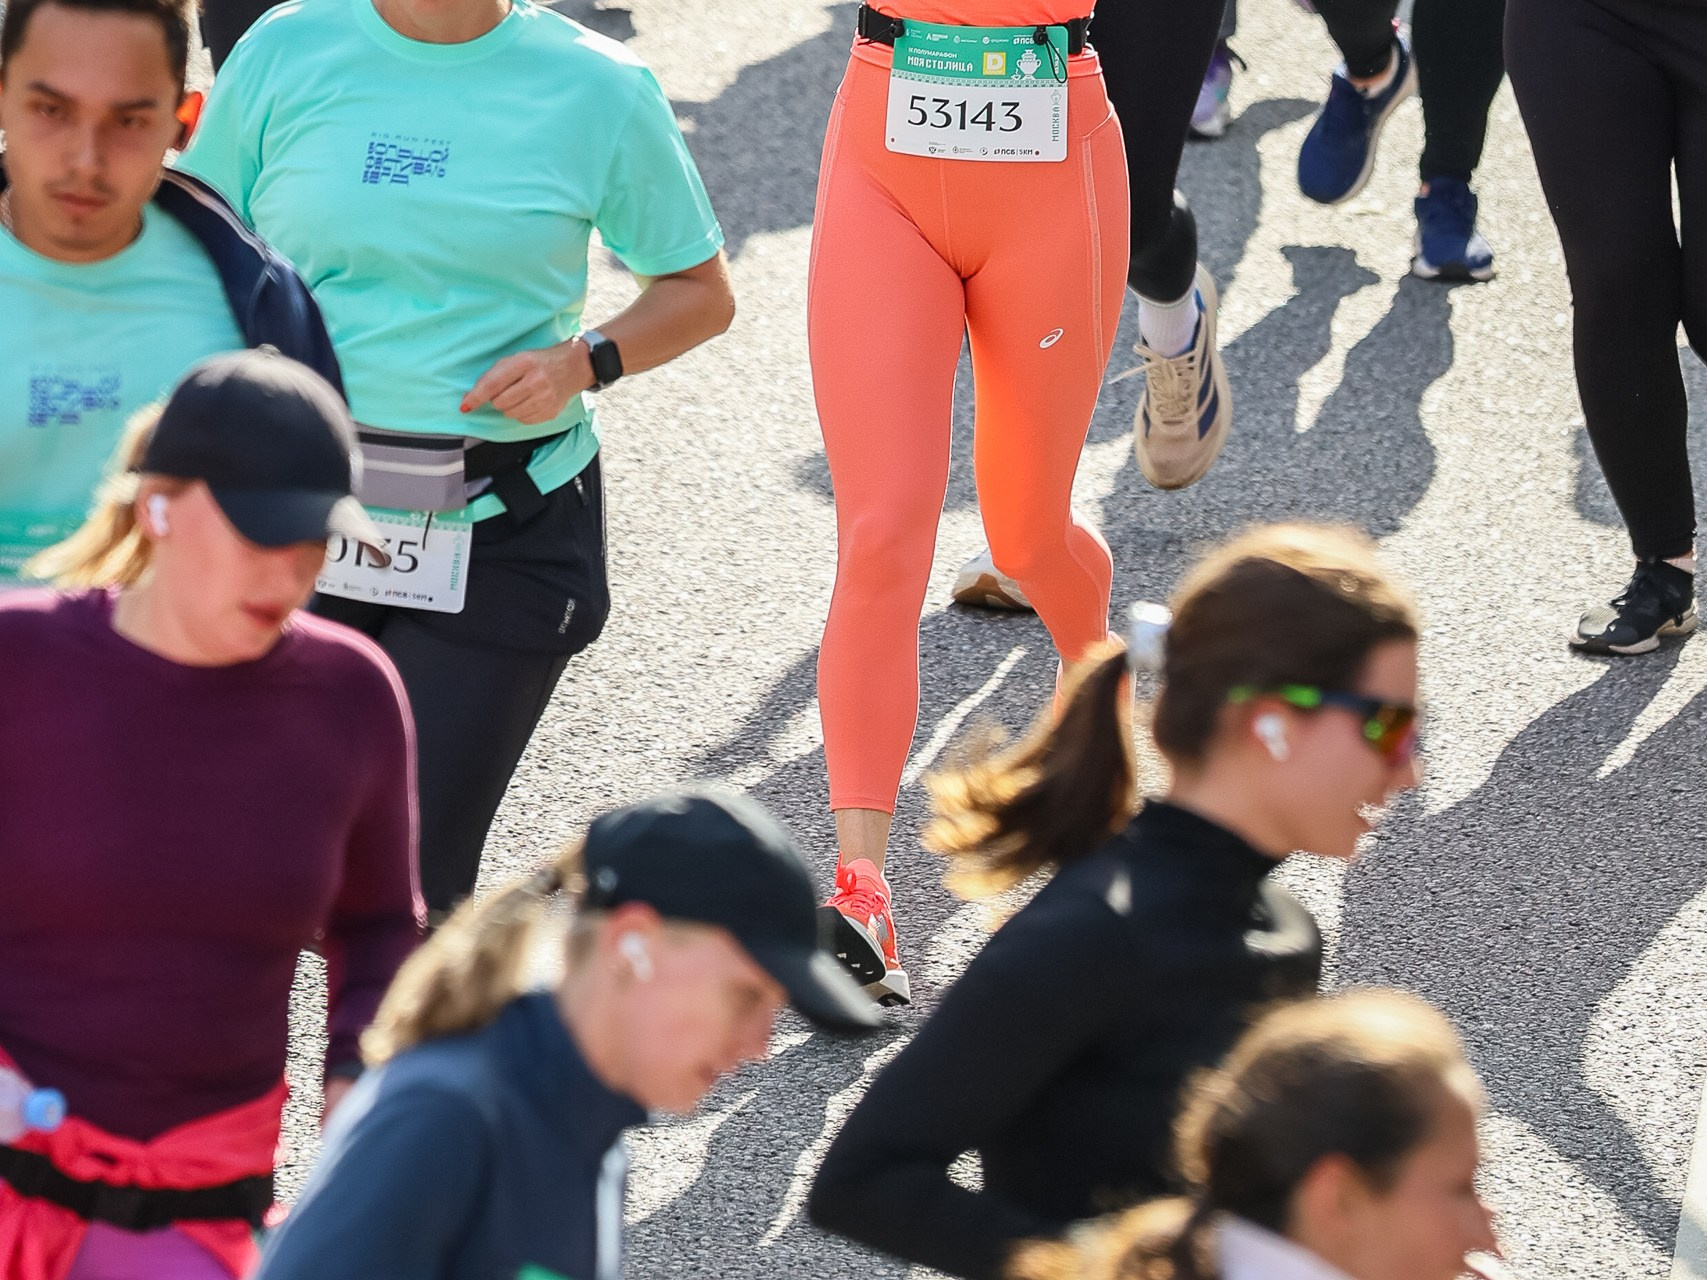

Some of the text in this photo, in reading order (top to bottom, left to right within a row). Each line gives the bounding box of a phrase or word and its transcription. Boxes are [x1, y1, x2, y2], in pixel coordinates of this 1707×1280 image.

[907, 56, 974, 72] МОЯ СТОЛИЦА
[987, 54, 1003, 70] D
[907, 94, 1023, 133] 53143
[1051, 105, 1060, 142] МОСКВА
